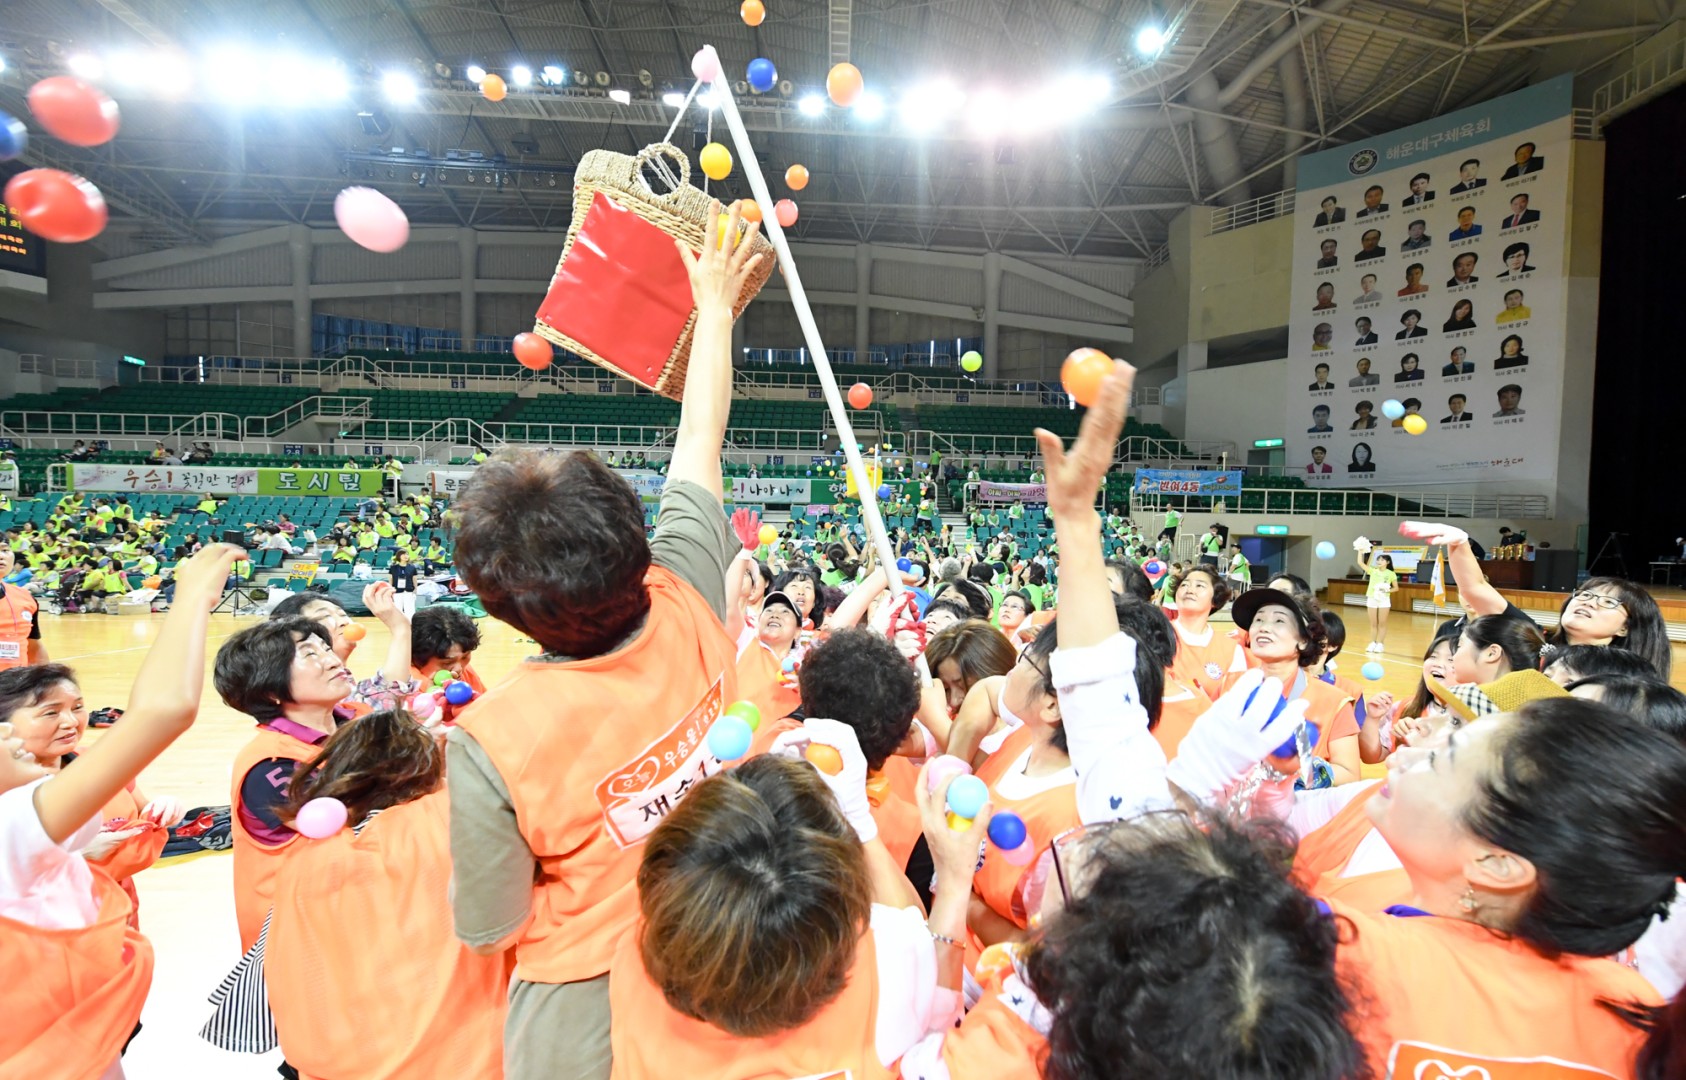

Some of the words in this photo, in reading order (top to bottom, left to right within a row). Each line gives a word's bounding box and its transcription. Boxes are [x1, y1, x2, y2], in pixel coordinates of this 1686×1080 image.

[1386, 117, 1490, 160] 해운대구체육회
[123, 468, 173, 489] 우승!
[182, 472, 221, 489] 꽃길만
[275, 471, 361, 491] 도시팀
[1160, 480, 1201, 493] 반여4동
[664, 719, 703, 768] 우승을!
